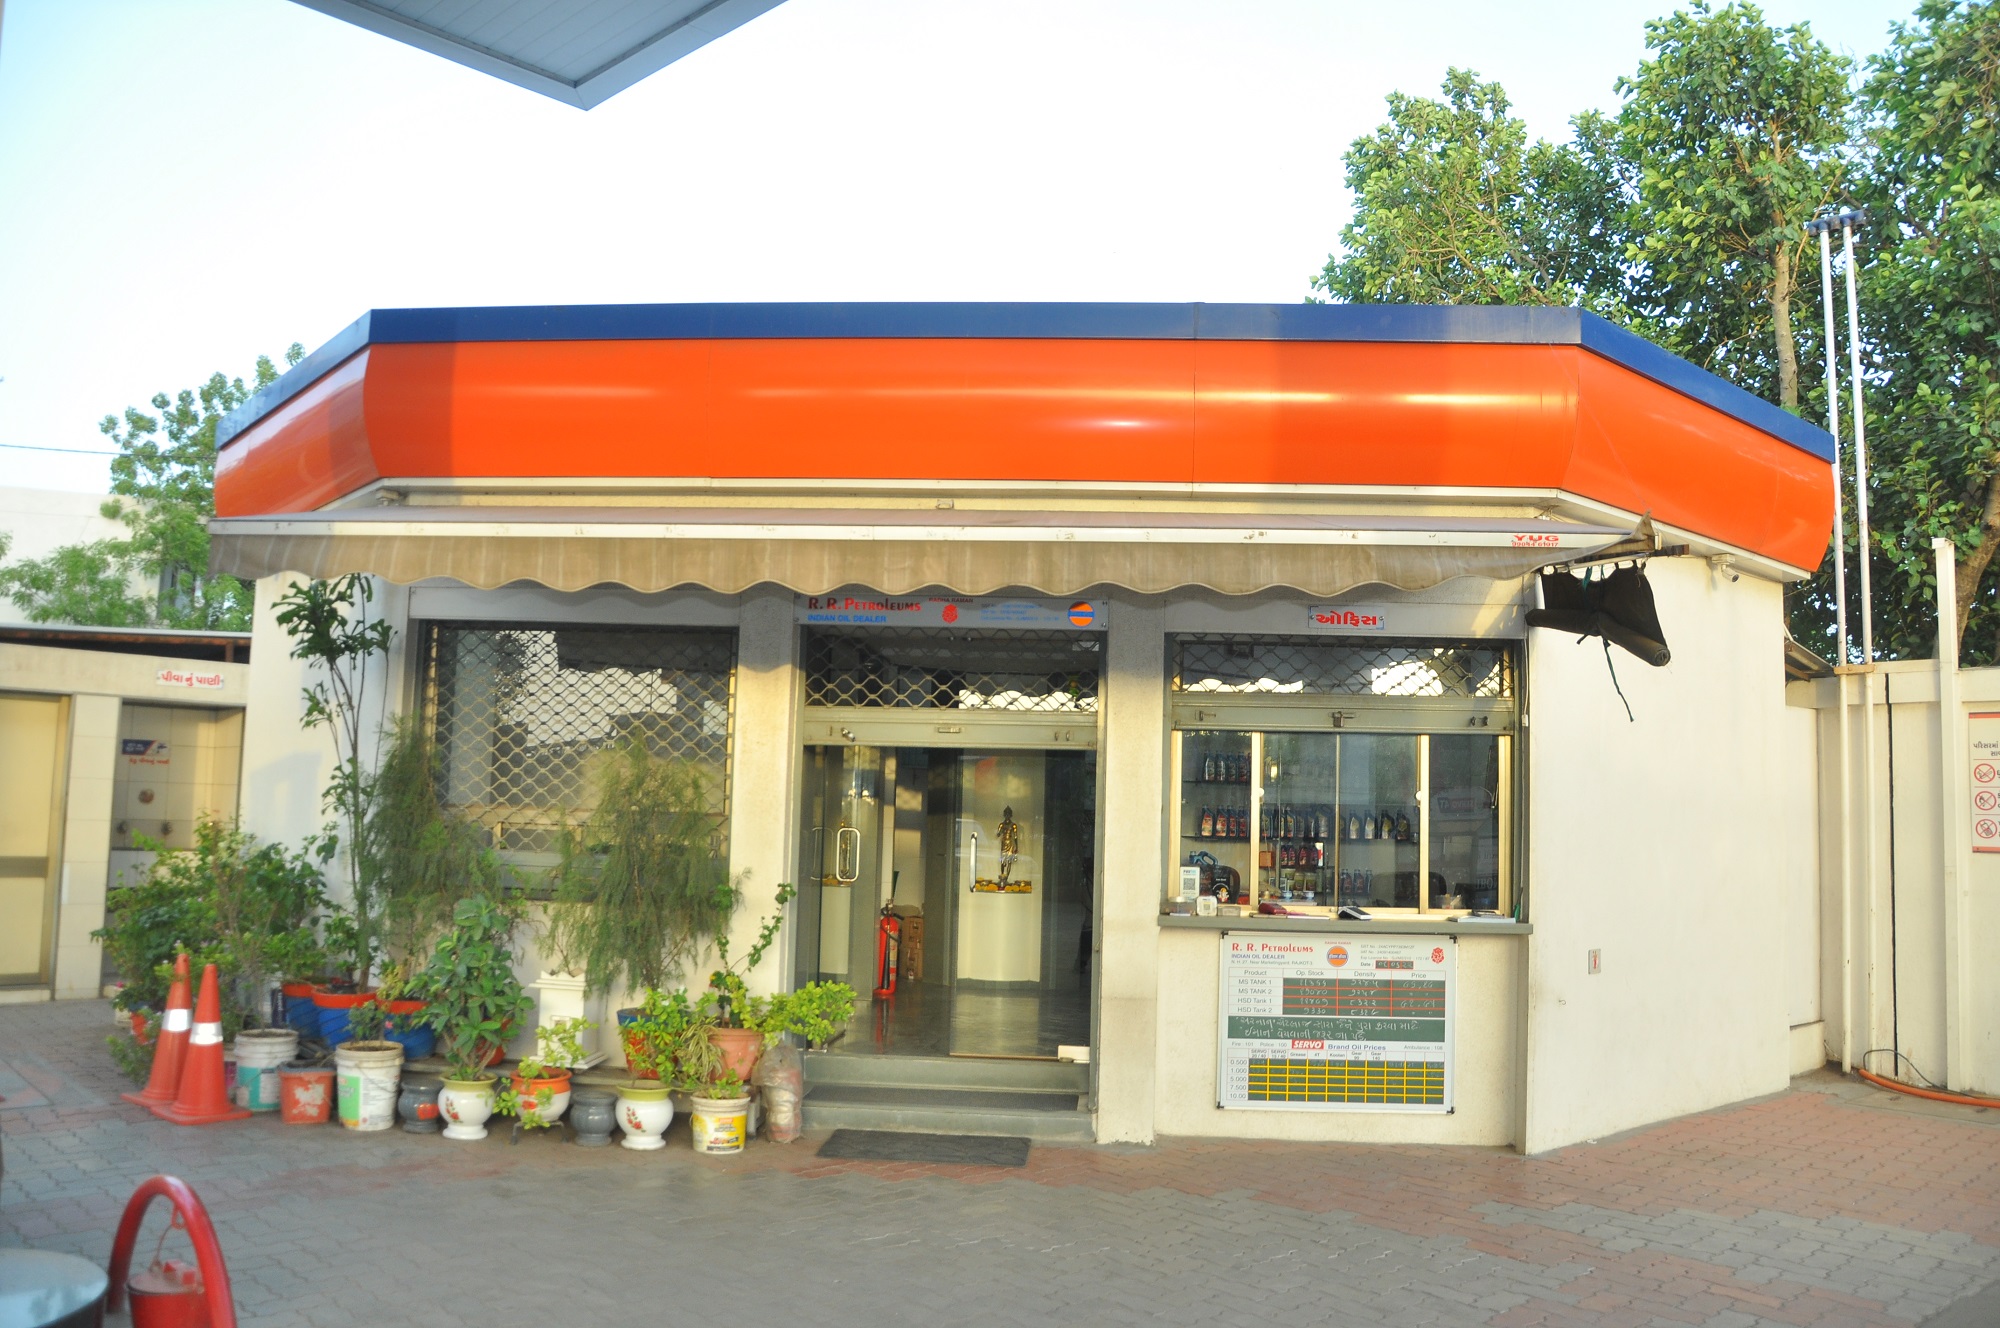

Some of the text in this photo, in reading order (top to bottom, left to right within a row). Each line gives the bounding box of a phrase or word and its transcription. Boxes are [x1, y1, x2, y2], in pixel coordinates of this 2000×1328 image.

[808, 598, 823, 610] R.
[826, 598, 842, 610] R.
[1316, 610, 1376, 626] ઓફિસ
[162, 670, 183, 682] પીવા
[196, 674, 220, 686] પાણી
[1232, 943, 1242, 951] R.
[1247, 943, 1257, 952] R.
[1293, 1040, 1321, 1048] SERVO
